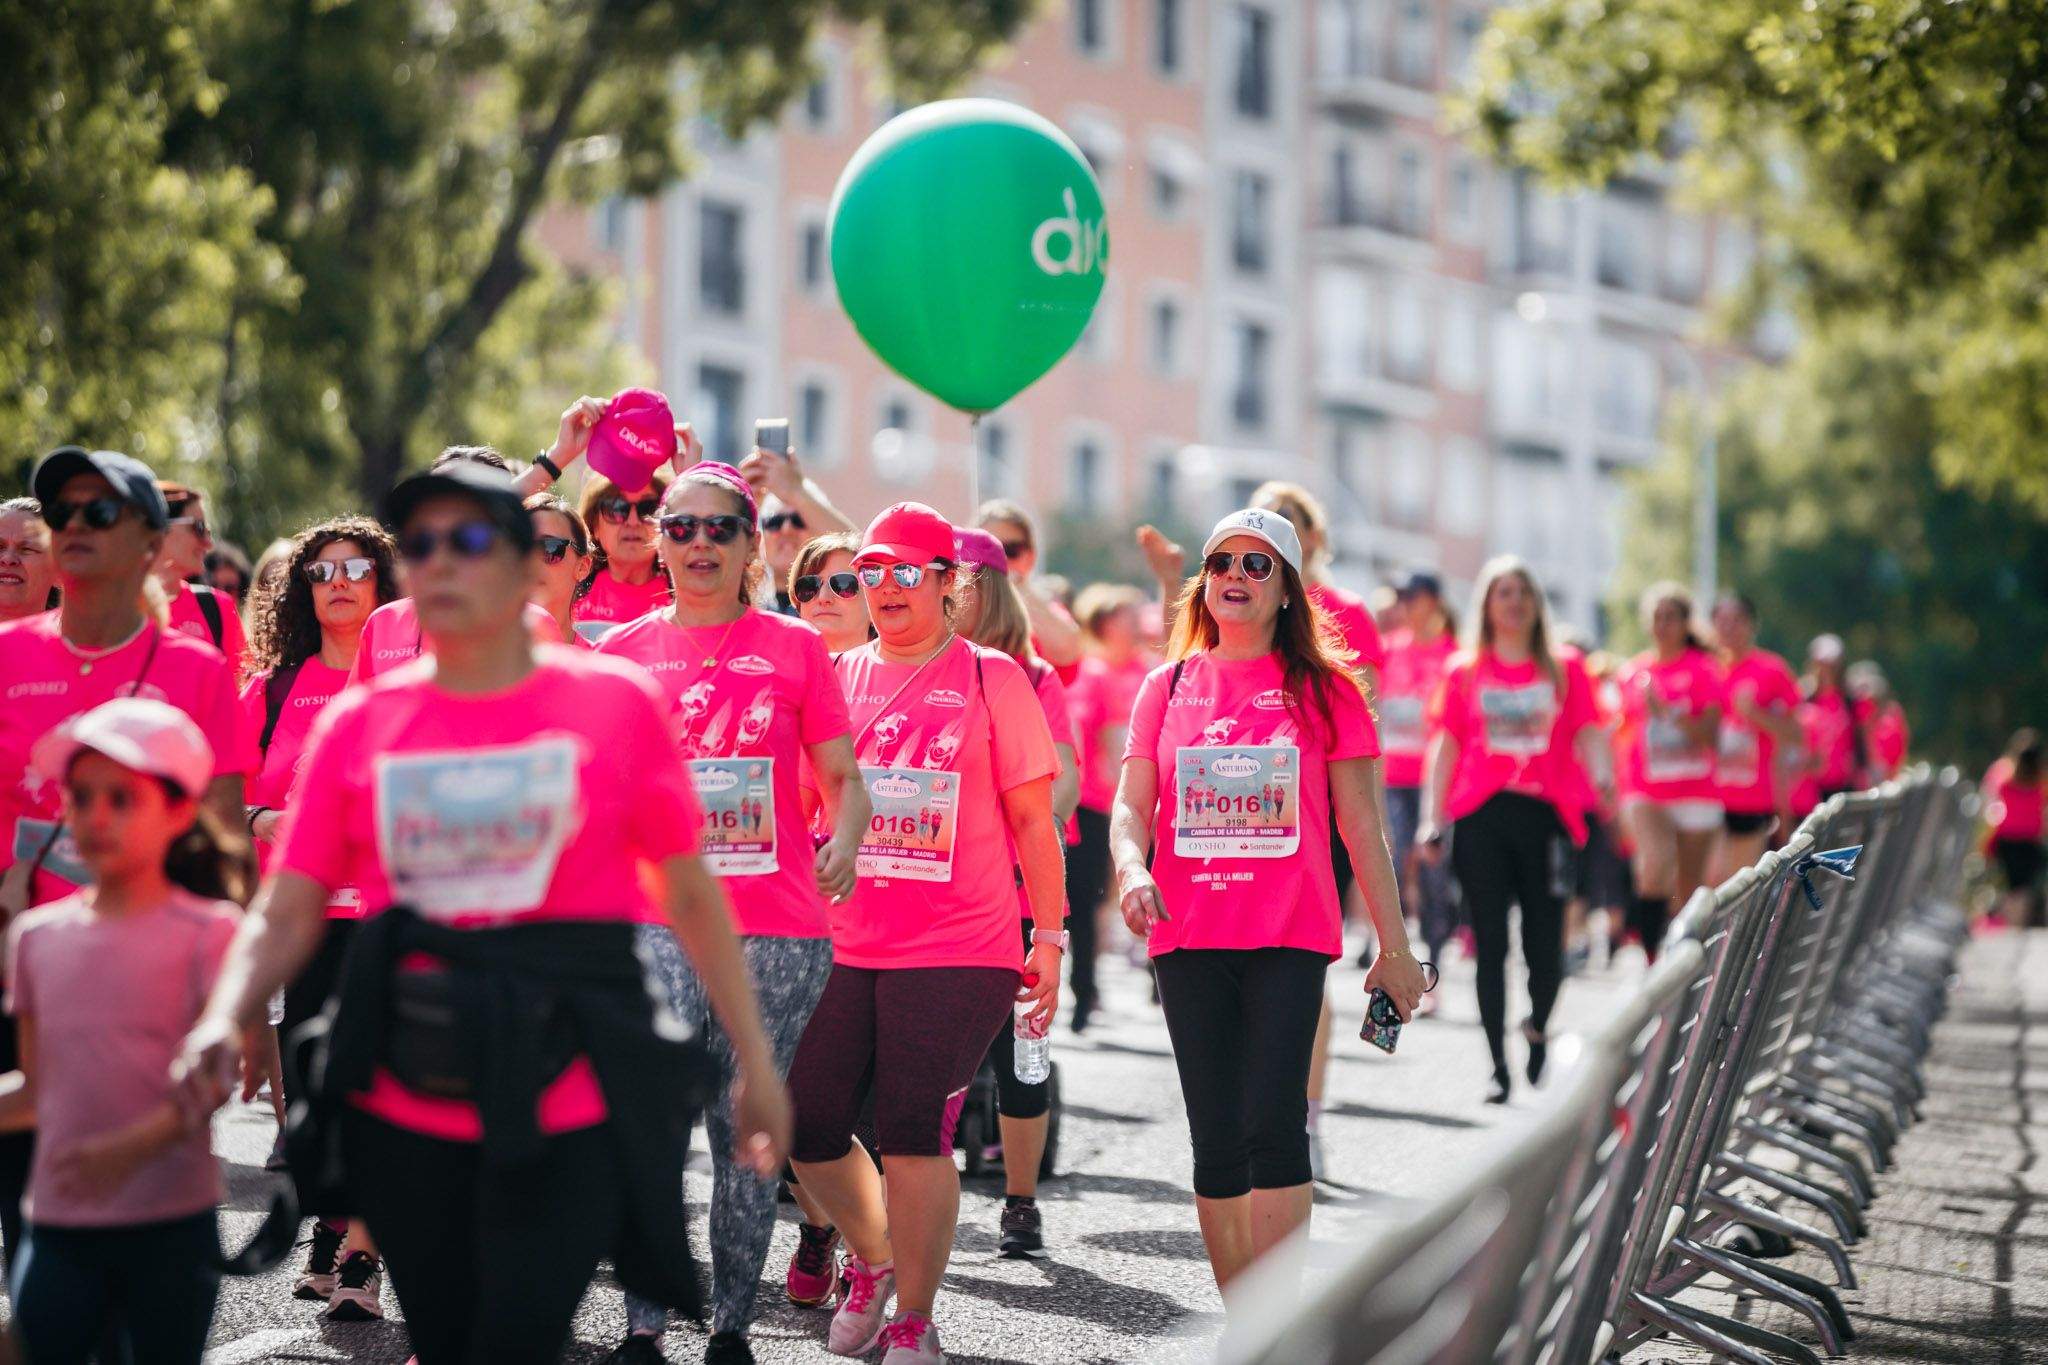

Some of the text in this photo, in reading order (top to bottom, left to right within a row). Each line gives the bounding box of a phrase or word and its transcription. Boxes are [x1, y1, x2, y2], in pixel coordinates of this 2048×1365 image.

[1168, 697, 1215, 707] OYSHO
[1214, 763, 1258, 772] ASTURIANA
[875, 783, 918, 793] ASTURIANA
[1216, 795, 1260, 813] 016
[871, 814, 916, 834] 016
[1226, 818, 1247, 827] 9198
[877, 837, 903, 846] 30439
[1189, 842, 1285, 851] OYSHO Santander
[888, 848, 908, 856] MUJER
[858, 860, 937, 874] SHO Santander
[1213, 873, 1222, 881] DE
[1223, 873, 1231, 881] LA
[1232, 872, 1254, 881] MUJER
[1211, 882, 1227, 890] 2024
